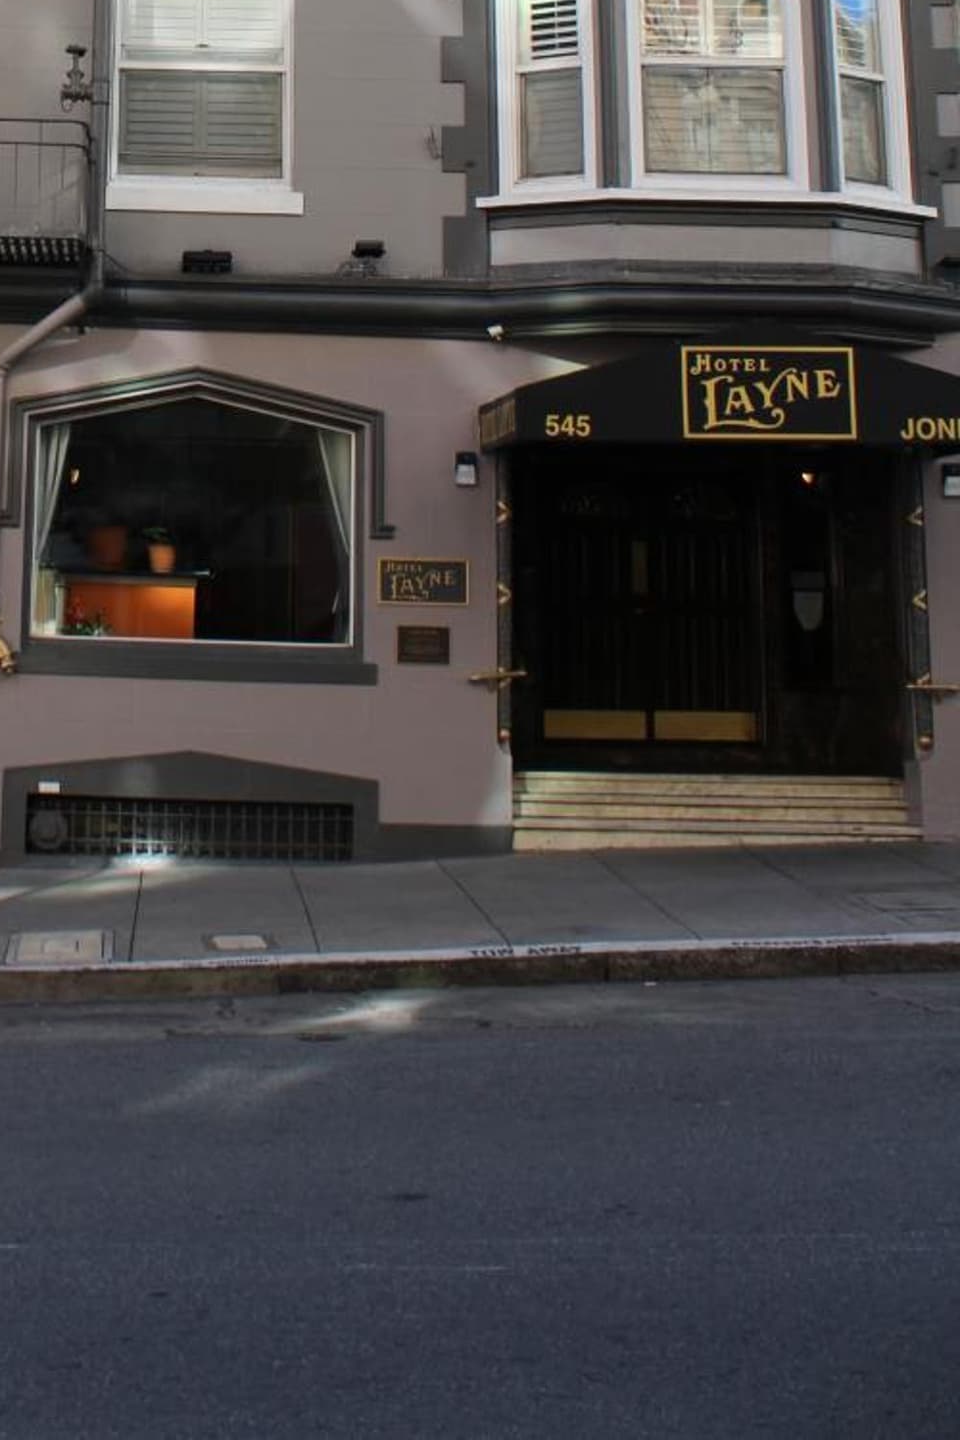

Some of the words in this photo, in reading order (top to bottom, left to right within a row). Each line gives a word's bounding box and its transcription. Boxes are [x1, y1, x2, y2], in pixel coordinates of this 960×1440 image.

[690, 354, 770, 375] HOTEL
[700, 368, 841, 430] LAYNE
[545, 414, 590, 437] 545
[900, 417, 960, 440] JON
